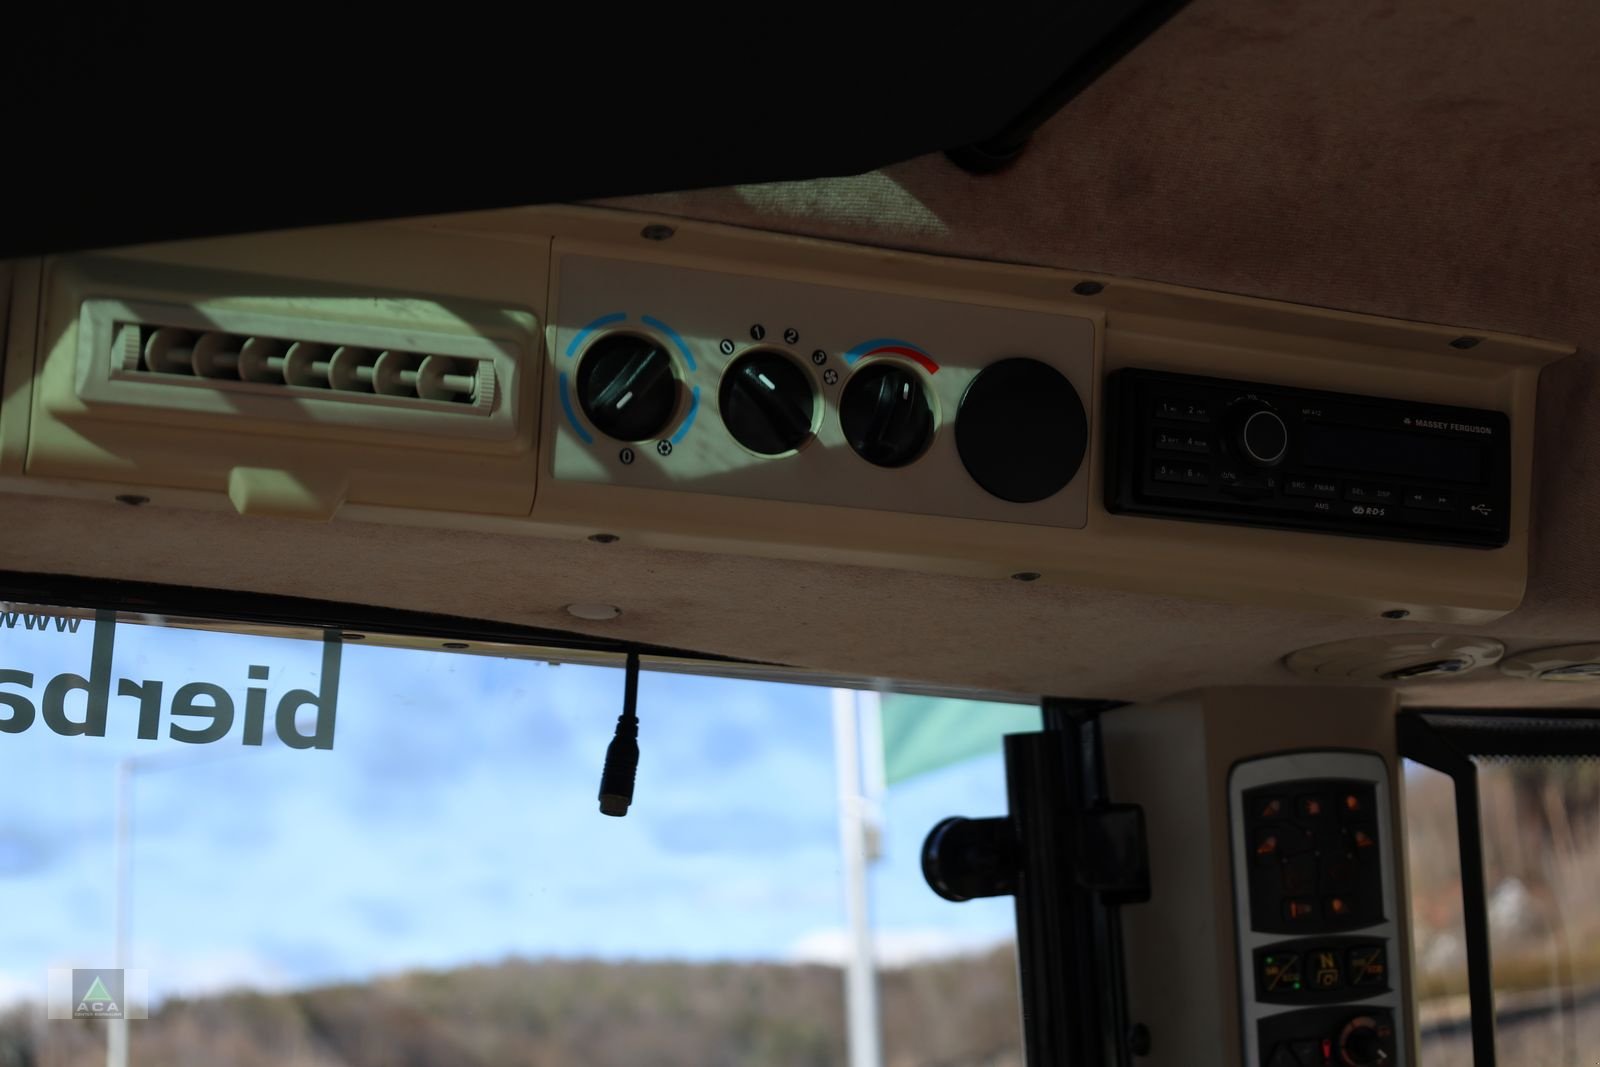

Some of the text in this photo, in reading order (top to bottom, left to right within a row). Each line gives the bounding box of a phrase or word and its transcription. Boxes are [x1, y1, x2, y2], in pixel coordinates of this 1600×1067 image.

[786, 329, 796, 343] 2
[721, 340, 733, 354] 0
[814, 350, 825, 363] 3
[1415, 418, 1492, 435] MASSEY FERGUSON
[622, 448, 633, 465] 0
[1319, 952, 1335, 969] N
